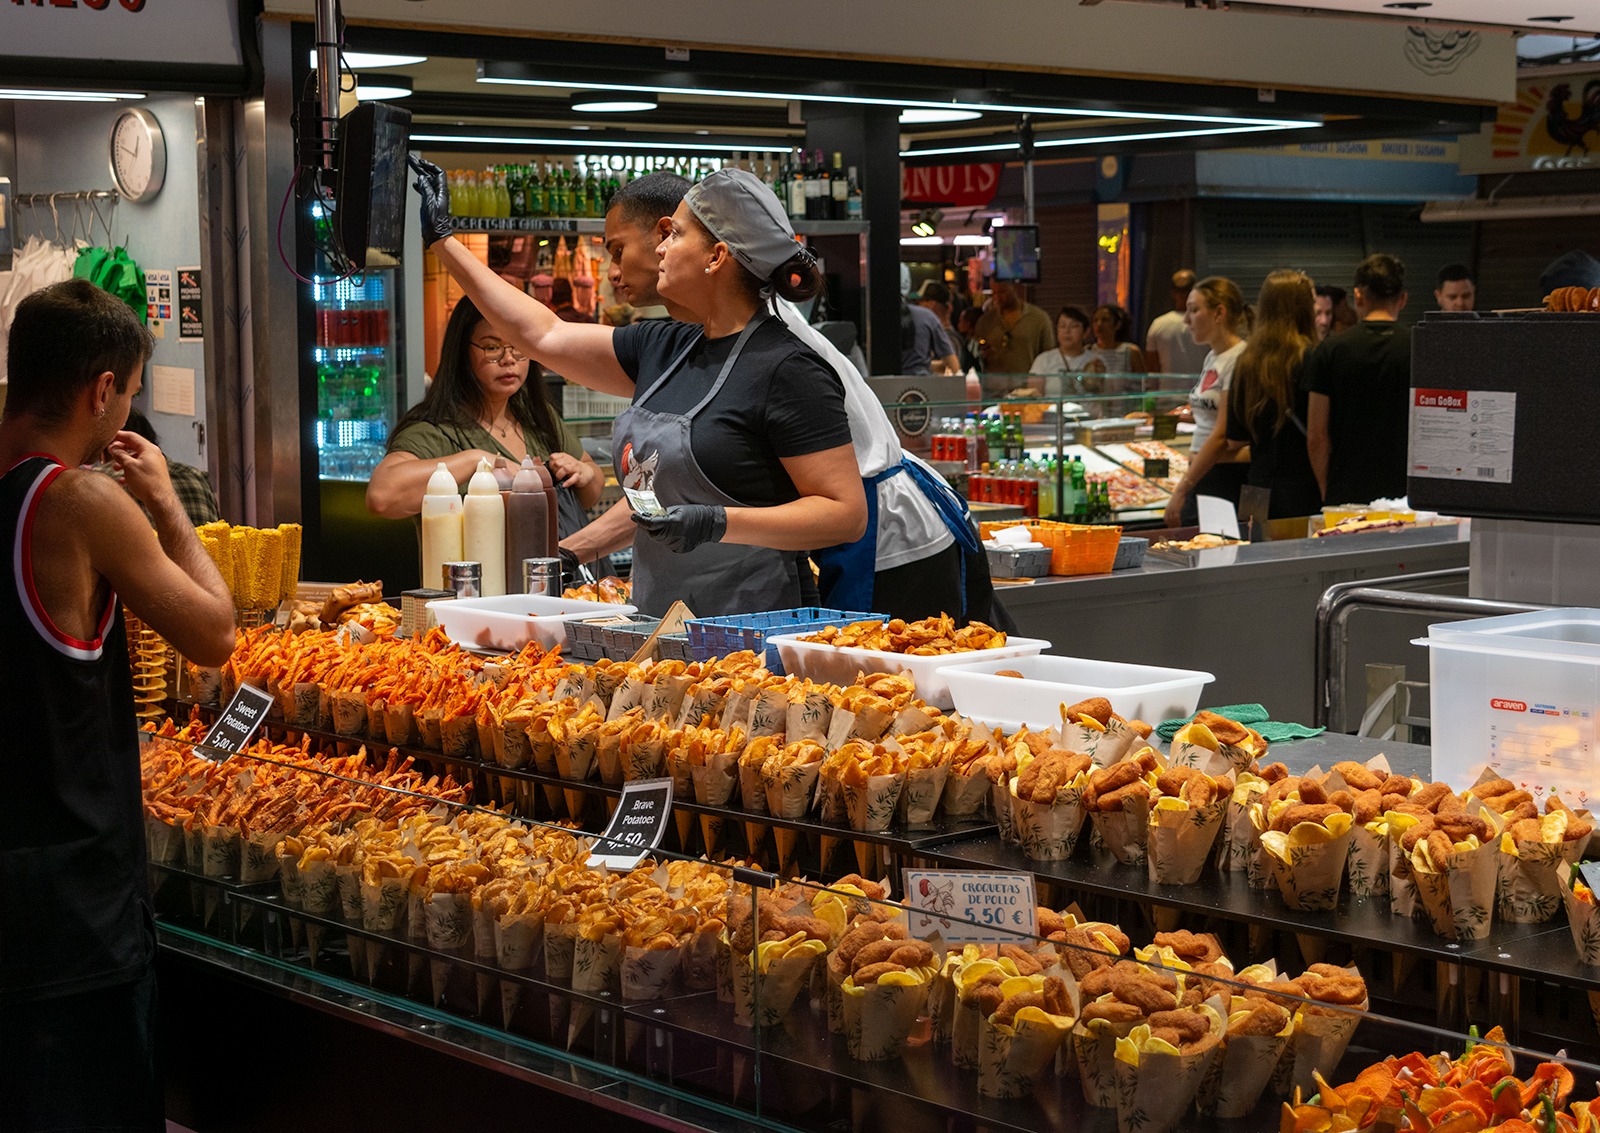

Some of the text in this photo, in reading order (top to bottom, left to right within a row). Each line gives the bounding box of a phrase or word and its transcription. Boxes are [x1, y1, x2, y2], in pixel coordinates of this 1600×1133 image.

[1419, 394, 1463, 407] Cam GoBox
[235, 701, 257, 719] Sweet
[1493, 700, 1524, 710] araven
[223, 714, 250, 734] Potatoes
[632, 800, 654, 810] Brave
[622, 815, 656, 825] Potatoes
[962, 883, 1020, 894] CROQUETAS
[968, 895, 1017, 906] DE POLLO
[1012, 910, 1024, 925] €
